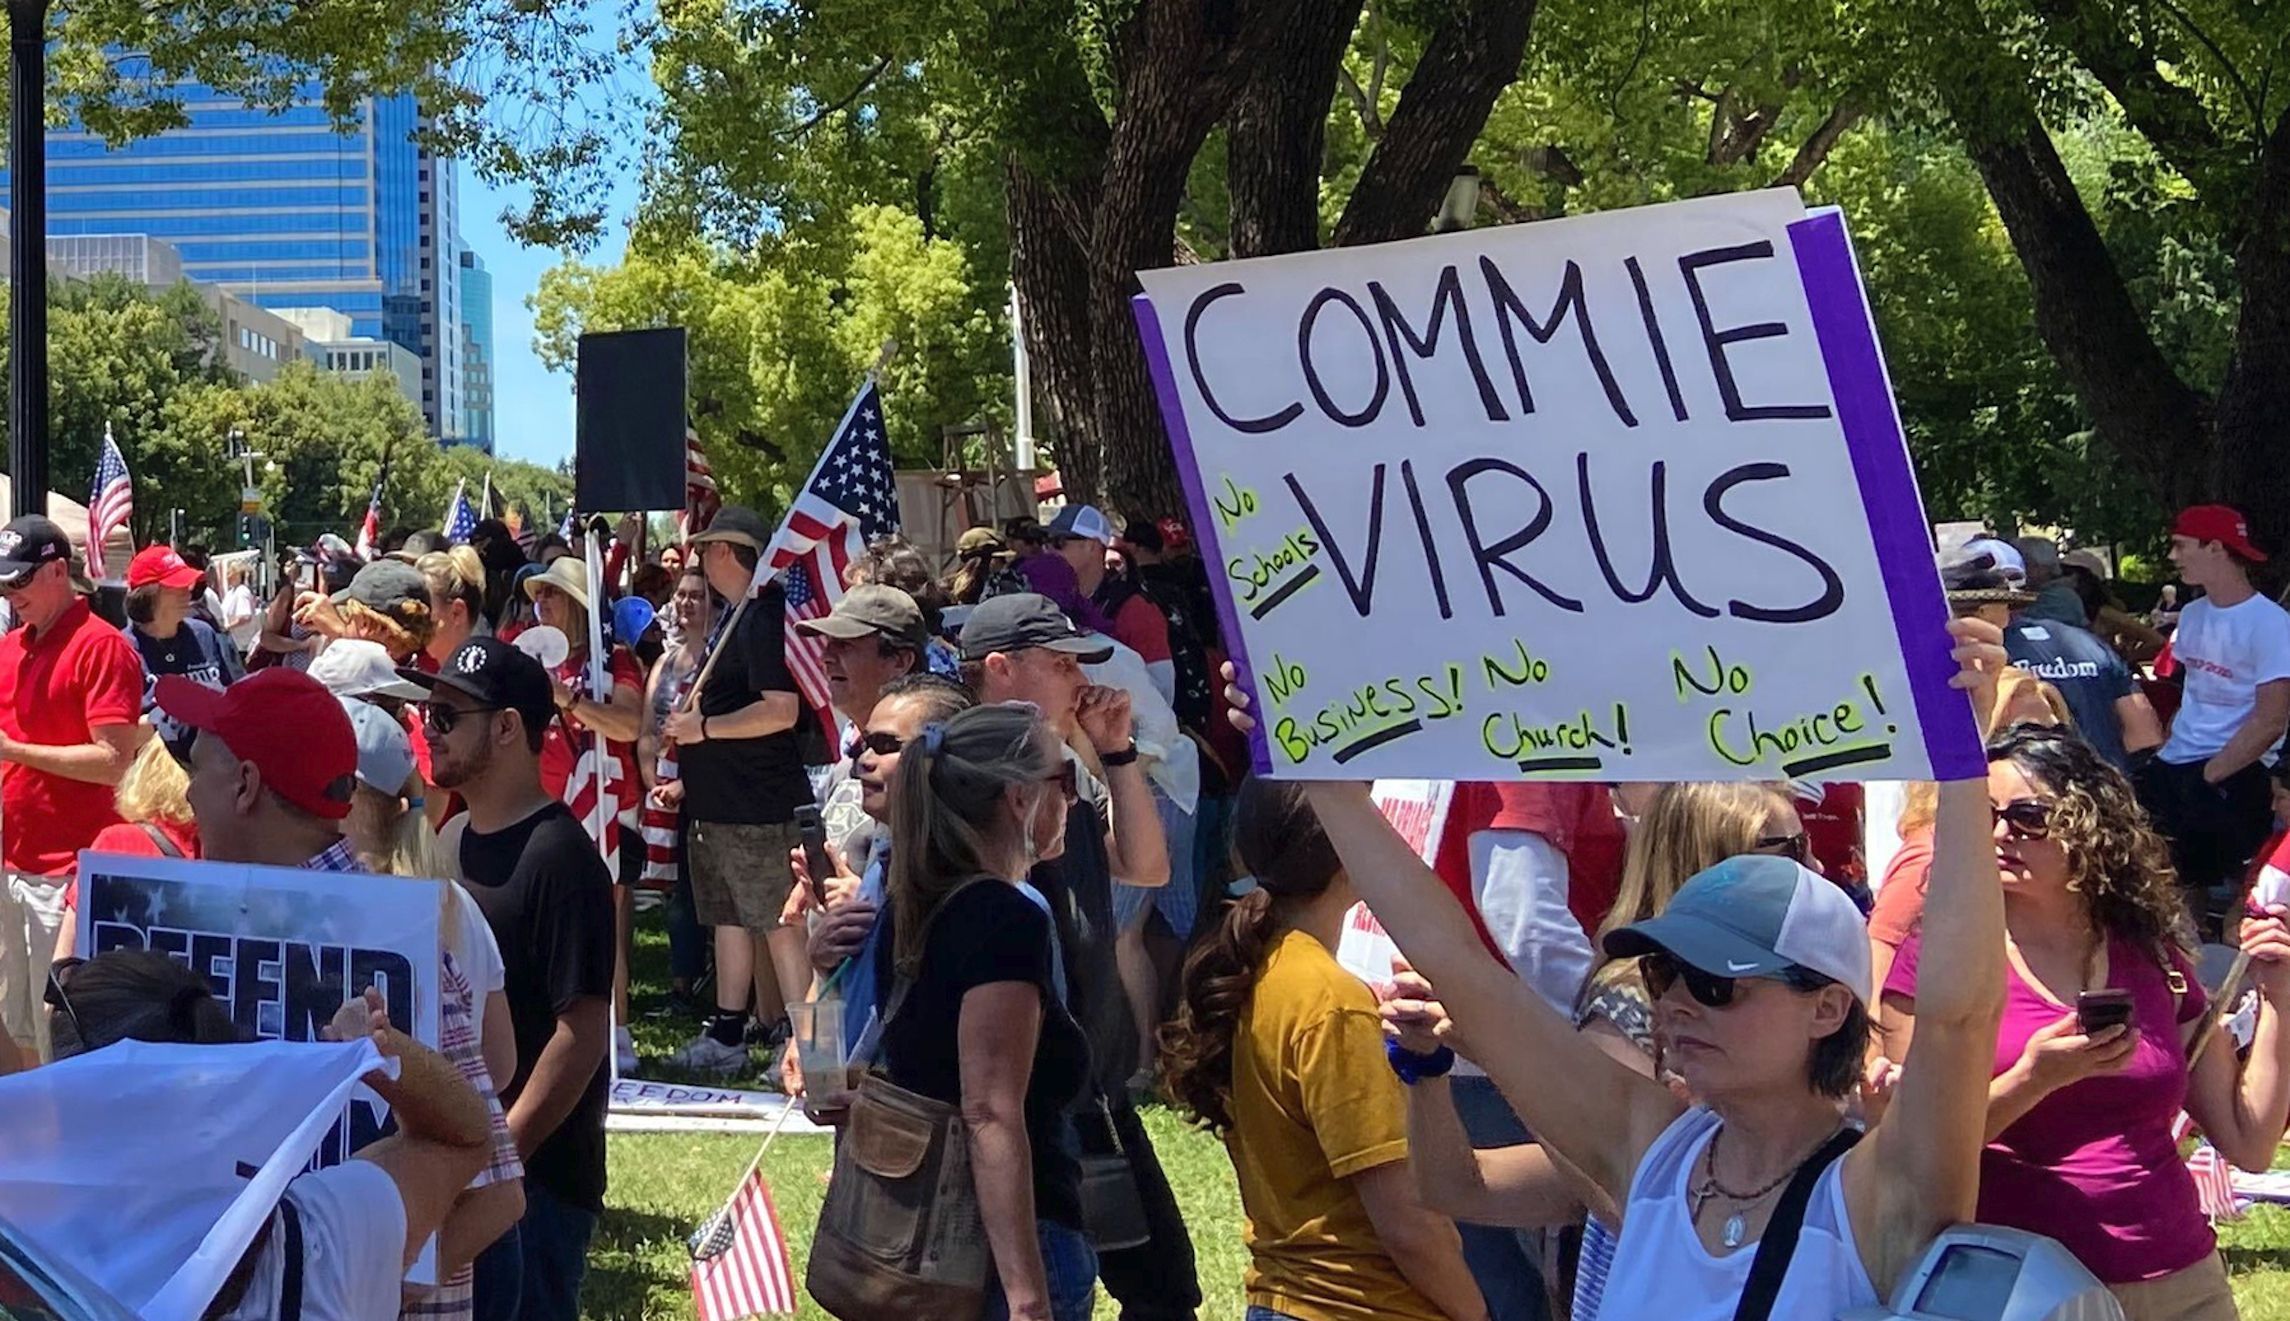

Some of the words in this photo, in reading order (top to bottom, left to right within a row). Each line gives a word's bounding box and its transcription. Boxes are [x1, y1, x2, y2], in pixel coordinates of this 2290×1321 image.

[1185, 239, 1832, 434] COMMIE
[1214, 477, 1255, 526] No
[1284, 452, 1845, 624] VIRUS
[1228, 533, 1320, 602] Schools
[1264, 653, 1305, 704] No
[1483, 639, 1548, 688] No
[1673, 645, 1749, 694] No
[1483, 703, 1633, 759] Church!
[1710, 674, 1897, 766] Choice!
